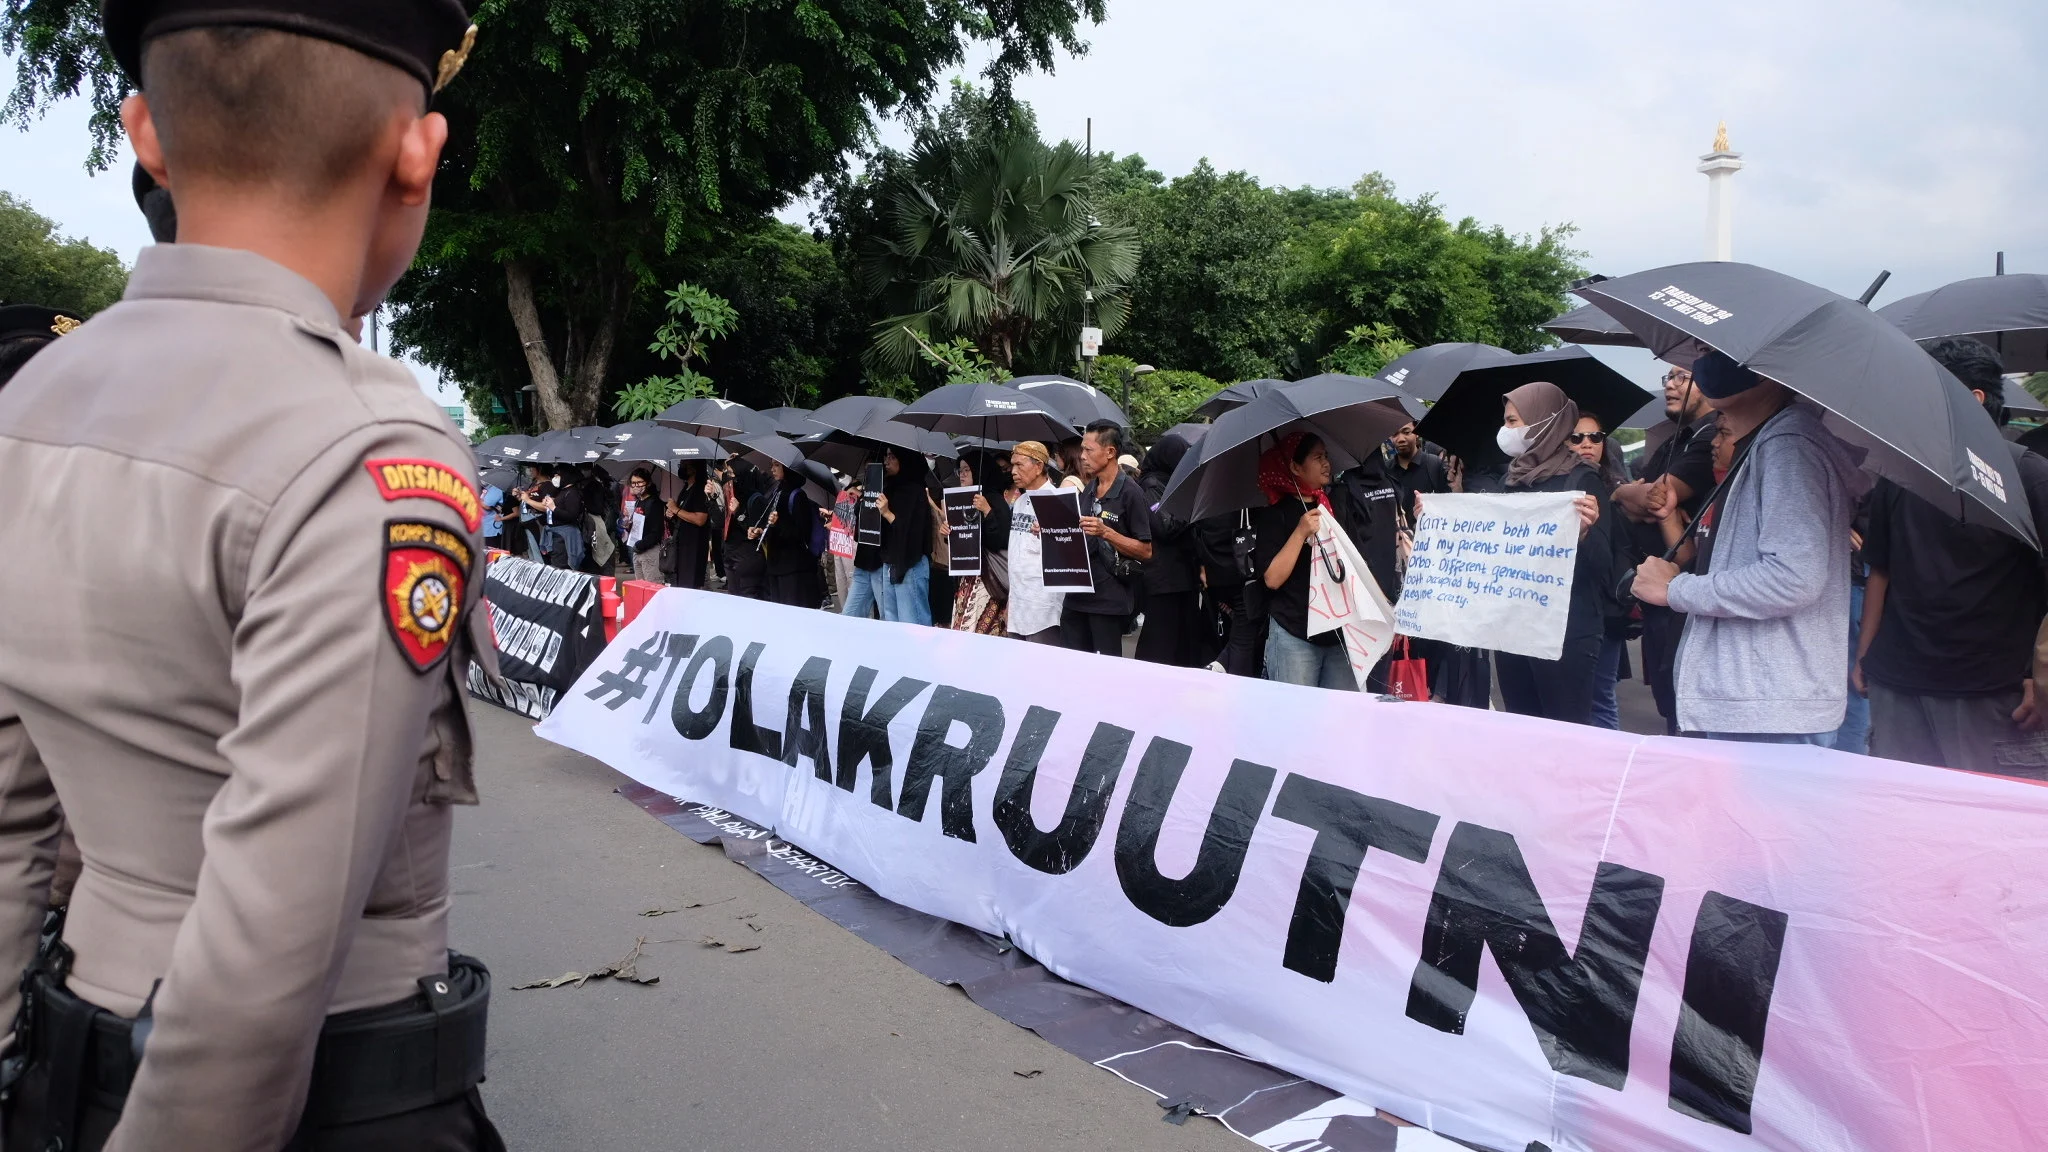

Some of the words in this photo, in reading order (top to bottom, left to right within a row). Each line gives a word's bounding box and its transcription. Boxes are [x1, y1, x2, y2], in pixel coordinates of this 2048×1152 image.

[1648, 291, 1666, 300] 13
[1673, 303, 1697, 315] MEI
[1690, 311, 1719, 325] 1998
[1661, 285, 1703, 305] TRAGEDI
[1694, 302, 1719, 313] MEI
[390, 524, 432, 543] KORPS
[1420, 513, 1448, 531] Can't
[1453, 518, 1495, 533] believe
[1503, 521, 1530, 538] both
[1536, 522, 1557, 536] me
[1413, 537, 1431, 552] and
[1437, 539, 1454, 554] my
[1456, 540, 1499, 557] parents
[1529, 545, 1574, 558] under
[1492, 565, 1564, 586] generations
[1406, 572, 1424, 585] both
[1467, 577, 1480, 594] by
[1483, 582, 1503, 596] the
[1508, 586, 1549, 607] same
